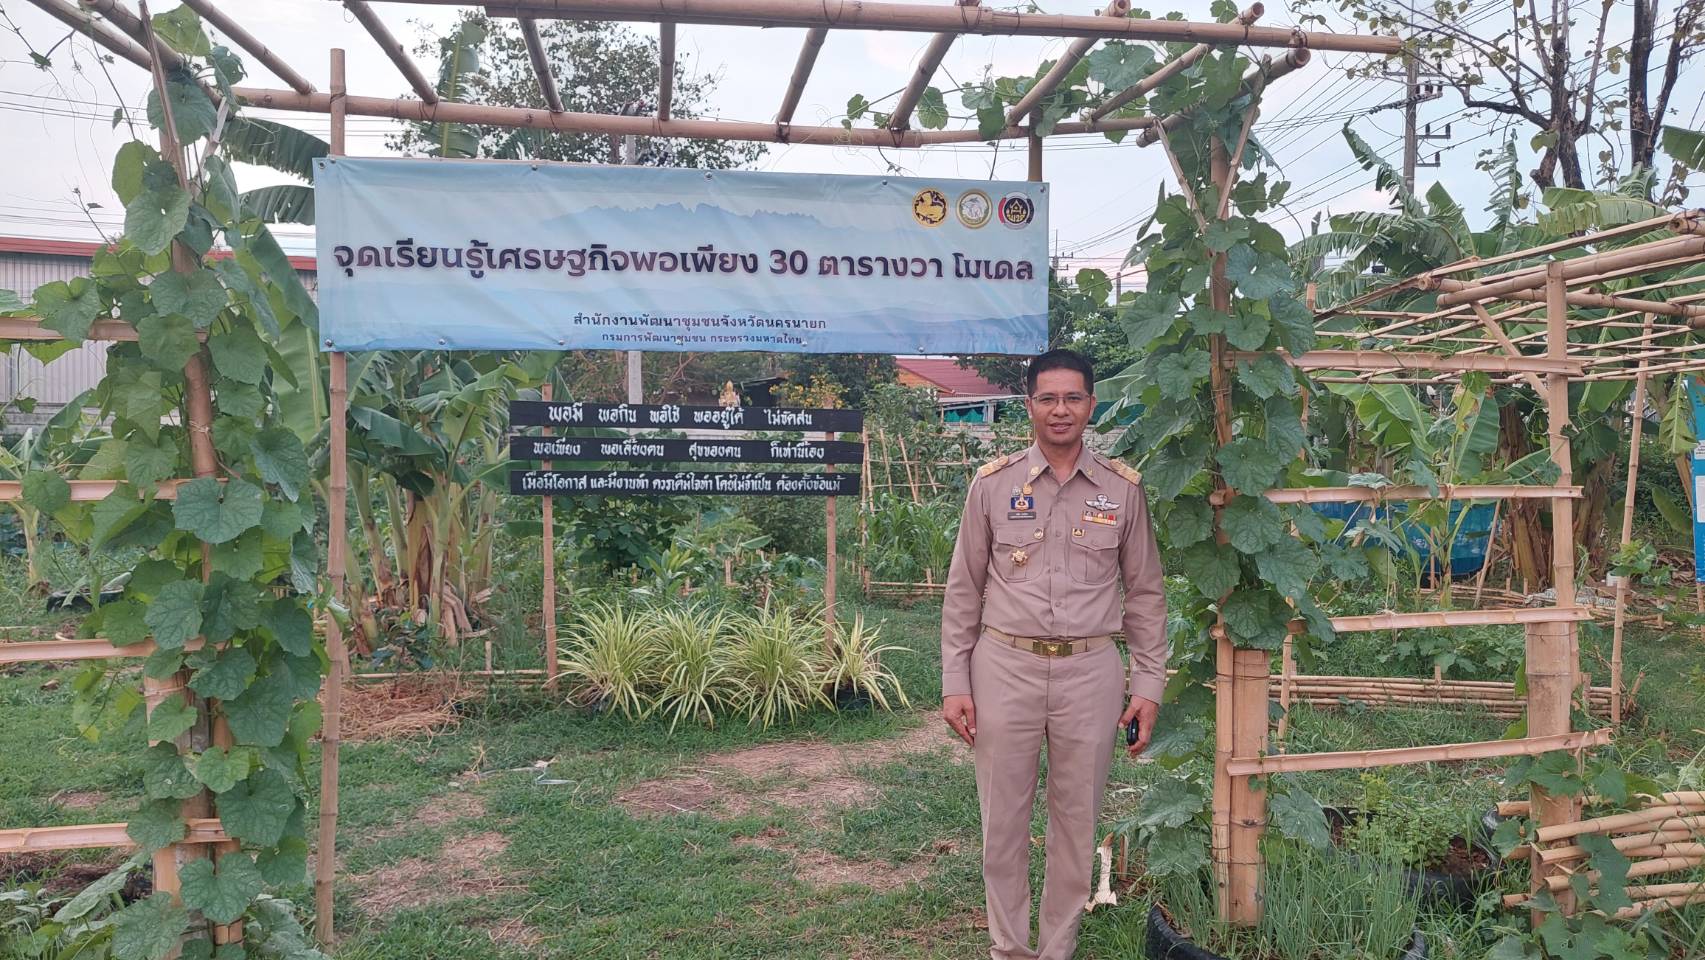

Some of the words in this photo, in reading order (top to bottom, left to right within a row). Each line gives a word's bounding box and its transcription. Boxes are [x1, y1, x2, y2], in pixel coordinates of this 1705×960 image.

[334, 237, 758, 279] จุดเรียนรู้เศรษฐกิจพอเพียง
[769, 250, 809, 276] 30
[818, 255, 944, 278] ตารางวา
[951, 252, 1034, 281] โมเดล
[573, 312, 827, 332] สำนักงานพัฒนาชุมชนจังหวัดนครนายก
[710, 332, 802, 345] กระทรวงมหาดไทย
[548, 403, 583, 423] พอมี
[598, 404, 637, 423] พอกิน
[649, 404, 680, 424] พอใช้
[693, 406, 744, 430] พออยู่ได้
[763, 408, 813, 426] ไม่ขัดสน
[533, 437, 581, 456] พอเพียง
[522, 470, 587, 490] เมื่อมีโอกาส
[590, 471, 649, 490] และมีงานทำ
